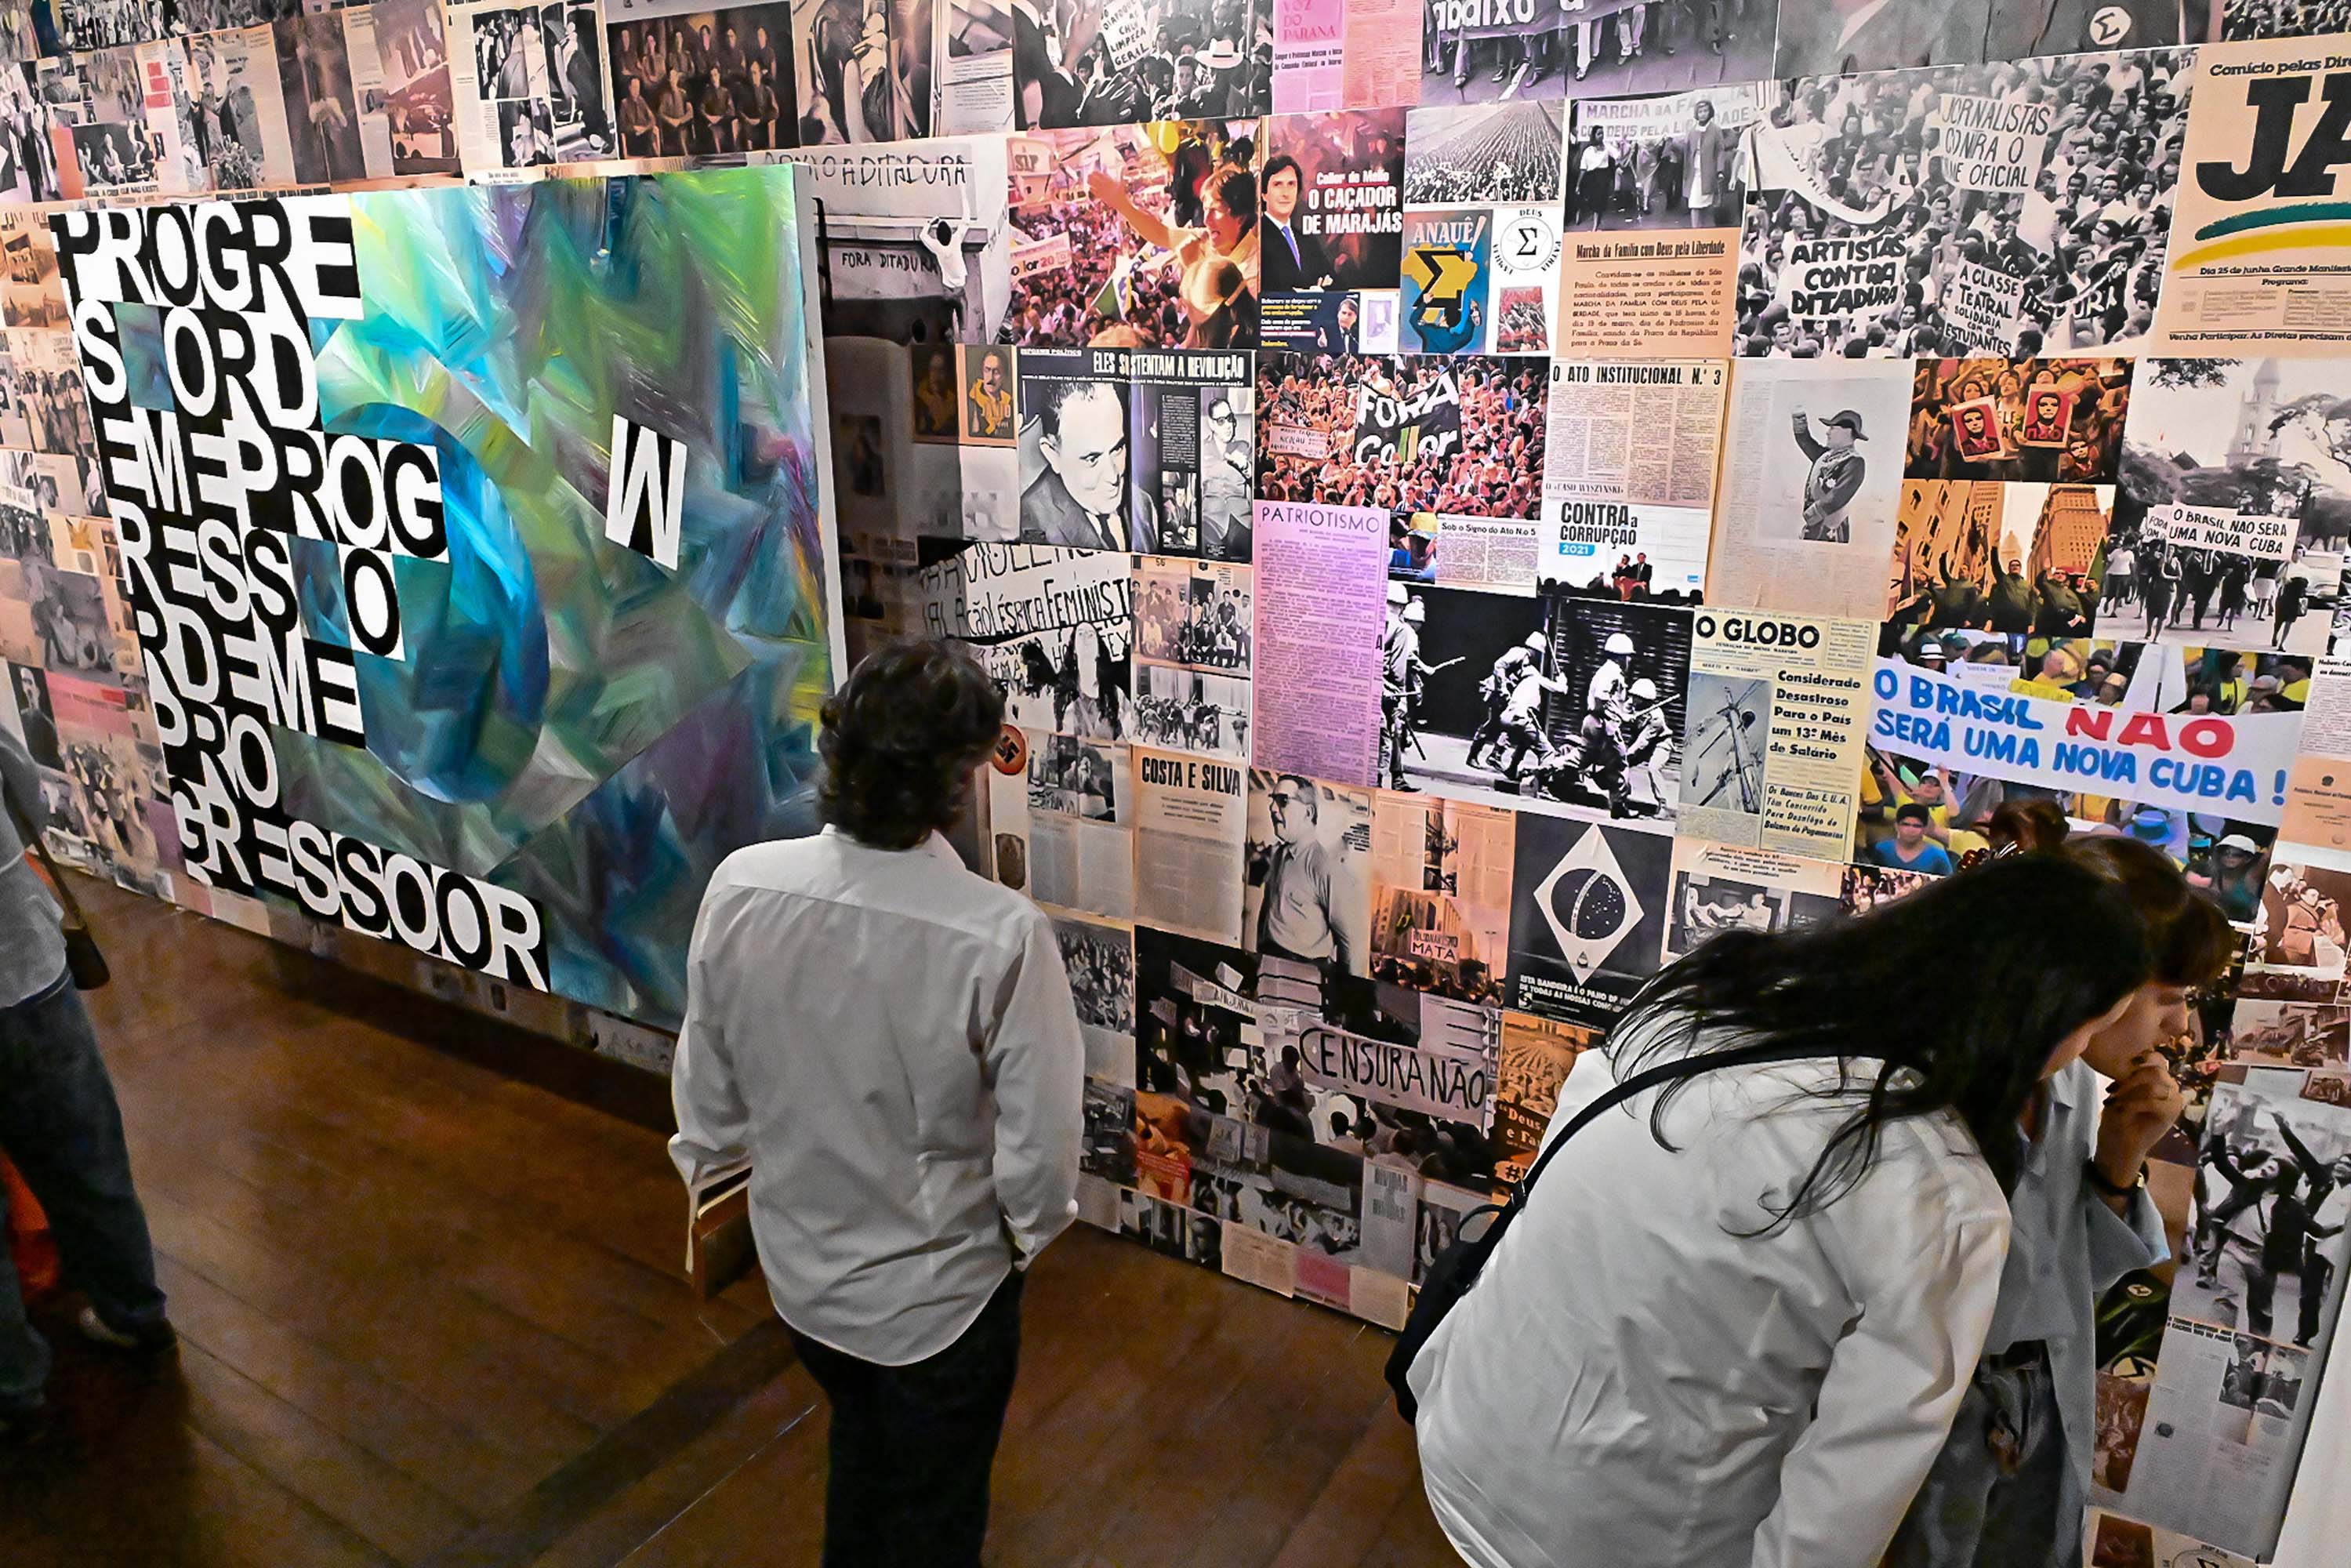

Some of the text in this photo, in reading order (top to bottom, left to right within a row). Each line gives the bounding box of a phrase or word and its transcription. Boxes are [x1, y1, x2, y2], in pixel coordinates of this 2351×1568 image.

[1284, 14, 1301, 27] DO
[1115, 44, 1148, 65] GERAL
[2210, 62, 2273, 76] Comício
[2277, 60, 2321, 74] pelas
[1587, 104, 1649, 118] MARCHA
[1608, 125, 1668, 137] DEUS PELA
[2008, 136, 2024, 164] O
[1316, 172, 1345, 185] Collor
[1348, 171, 1359, 183] de
[1969, 164, 2029, 187] OFICIAL
[1308, 187, 1396, 211] O CAÇADOR
[1302, 208, 1402, 235] DE MARAJÁS
[1519, 209, 1542, 217] DEUS
[1576, 244, 1600, 259] Marcha
[1603, 245, 1611, 257] da
[1640, 245, 1654, 256] com
[1656, 242, 1673, 256] Deus
[1674, 241, 1689, 257] pela
[1692, 240, 1725, 255] Liberdade
[1790, 233, 1906, 265] ARTISTAS
[842, 252, 938, 275] FORA DITADURA
[1804, 262, 1896, 290] CONTRA
[1960, 265, 2019, 296] A CLASSE
[1791, 285, 1898, 315] DITADURA
[1959, 283, 2012, 319] TEATRAL
[1954, 305, 2001, 329] SOLIDARIA
[1945, 322, 2012, 358] ESTUDANTES
[1051, 348, 1082, 357] POLÍTICO
[1094, 351, 1115, 373] ELES
[1177, 356, 1185, 377] A
[1188, 354, 1244, 380] REVOLUÇÃO
[1552, 365, 1560, 382] O
[1568, 365, 1590, 383] ATO
[1596, 366, 1682, 385] INSTITUCIONAL
[1714, 369, 1722, 385] 3
[1357, 371, 1459, 428] FORA
[1262, 506, 1380, 533] PATRIOTISMO
[1561, 502, 1638, 528] CONTRA a
[2174, 509, 2287, 537] O BRASIL NAO SERA
[1442, 522, 1457, 532] Sob
[1465, 524, 1487, 535] Signo
[1560, 524, 1637, 549] CORRUPÇÃO
[2149, 516, 2283, 554] FORA UMA NOVA CUBA
[1562, 545, 1589, 554] 2021
[1696, 615, 1716, 639] O
[1723, 618, 1819, 648] GLOBO
[1778, 670, 1861, 688] Considerado
[1776, 688, 1849, 706] Desastroso
[1874, 669, 1899, 700] O
[1910, 675, 2044, 731] BRASIL
[1774, 706, 1805, 719] Para
[1823, 712, 1851, 724] País
[1772, 727, 1791, 735] um
[1819, 730, 1846, 742] Mês
[1770, 742, 1837, 759] de Salário
[1874, 708, 1951, 752] SERÁ
[1964, 727, 2039, 769] UMA
[2052, 742, 2136, 784] NOVA
[2150, 757, 2256, 804] CUBA
[1142, 757, 1241, 797] COSTA E SILVA
[1769, 786, 1776, 795] Os
[1806, 791, 1819, 800] Das
[1765, 809, 1784, 818] Para
[1786, 800, 1827, 814] Concorrido
[1413, 942, 1456, 961] MATA
[1529, 985, 1552, 996] TODAS
[1564, 993, 1591, 1005] NOSSAS
[1537, 978, 1572, 993] BANDEIRA
[1587, 989, 1606, 1000] PANO
[1299, 1027, 1486, 1109] CENSURA NÃO
[1506, 1127, 1541, 1146] e Fa
